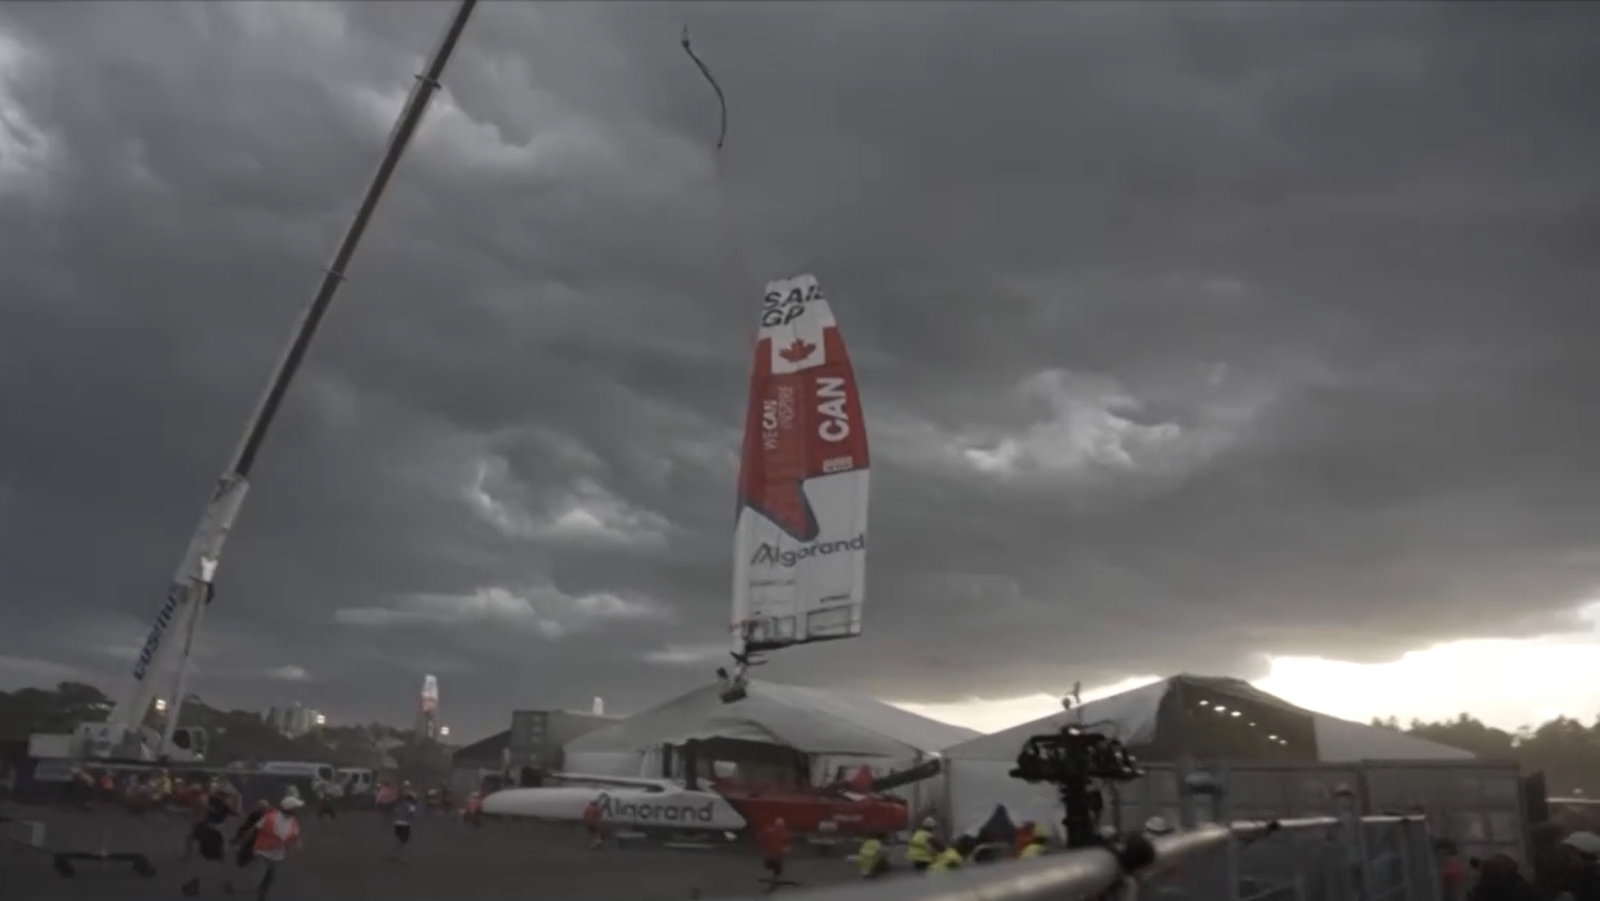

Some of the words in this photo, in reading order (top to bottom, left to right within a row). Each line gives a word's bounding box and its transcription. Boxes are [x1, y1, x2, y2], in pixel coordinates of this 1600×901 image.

[764, 285, 823, 310] SAIL
[761, 305, 805, 327] GP
[762, 400, 778, 430] CAN
[816, 377, 850, 442] CAN
[750, 534, 865, 568] Algorand
[597, 792, 714, 822] Algorand
